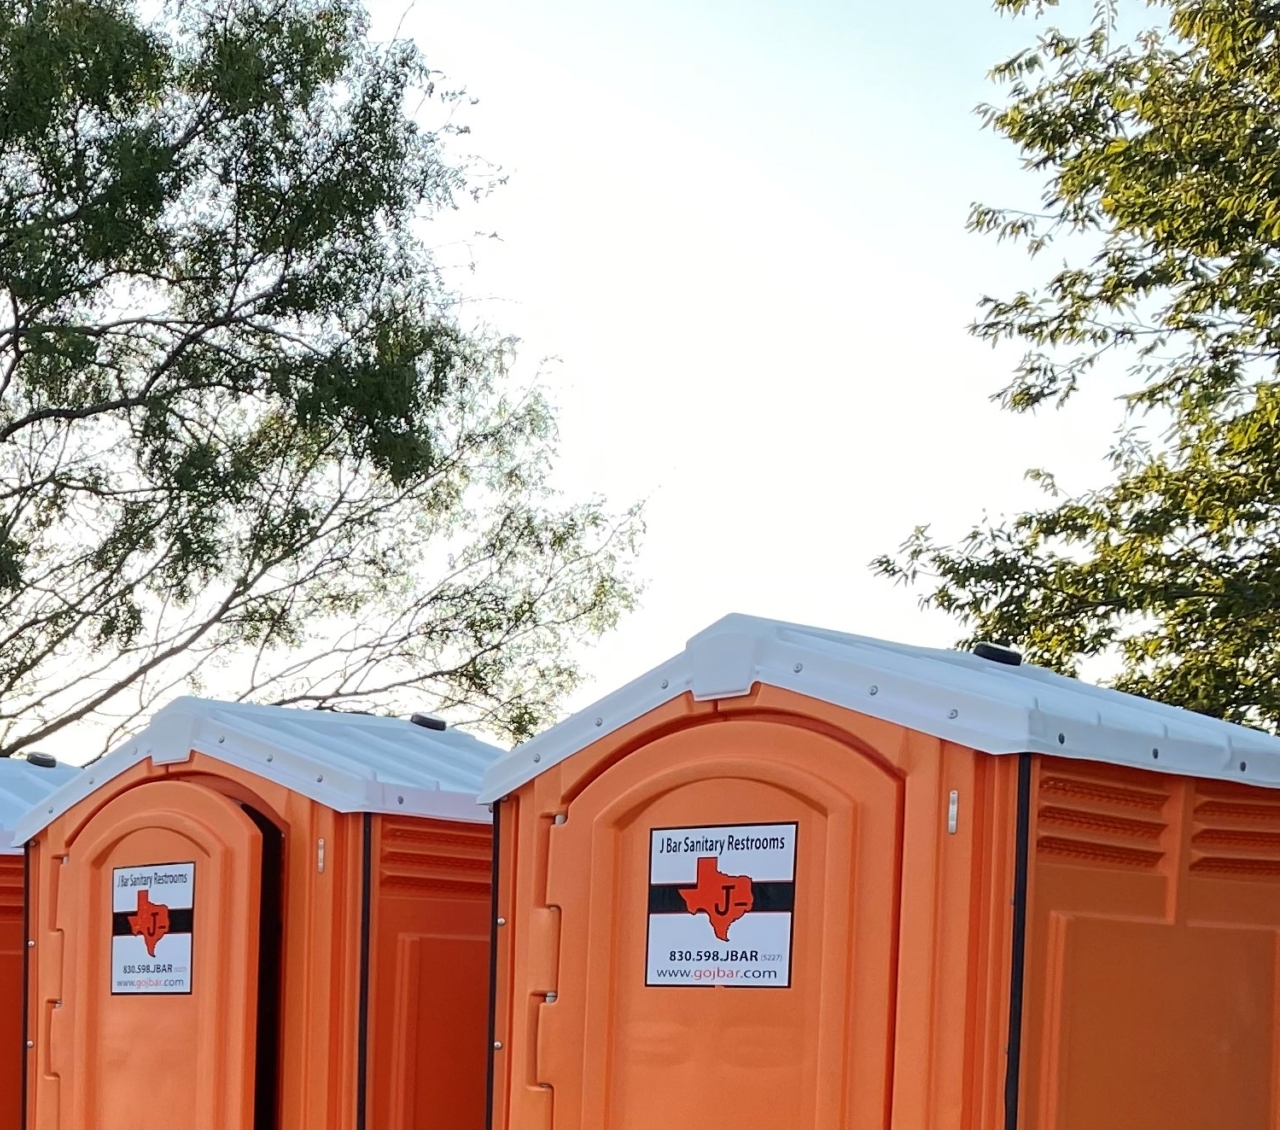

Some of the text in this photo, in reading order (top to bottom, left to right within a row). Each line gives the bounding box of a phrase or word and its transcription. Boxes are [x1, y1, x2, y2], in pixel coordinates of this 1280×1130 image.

[660, 834, 785, 856] J Bar Sanitary Restrooms
[669, 950, 759, 962] 830.598.JBAR
[656, 967, 777, 980] www.gojbar.com
